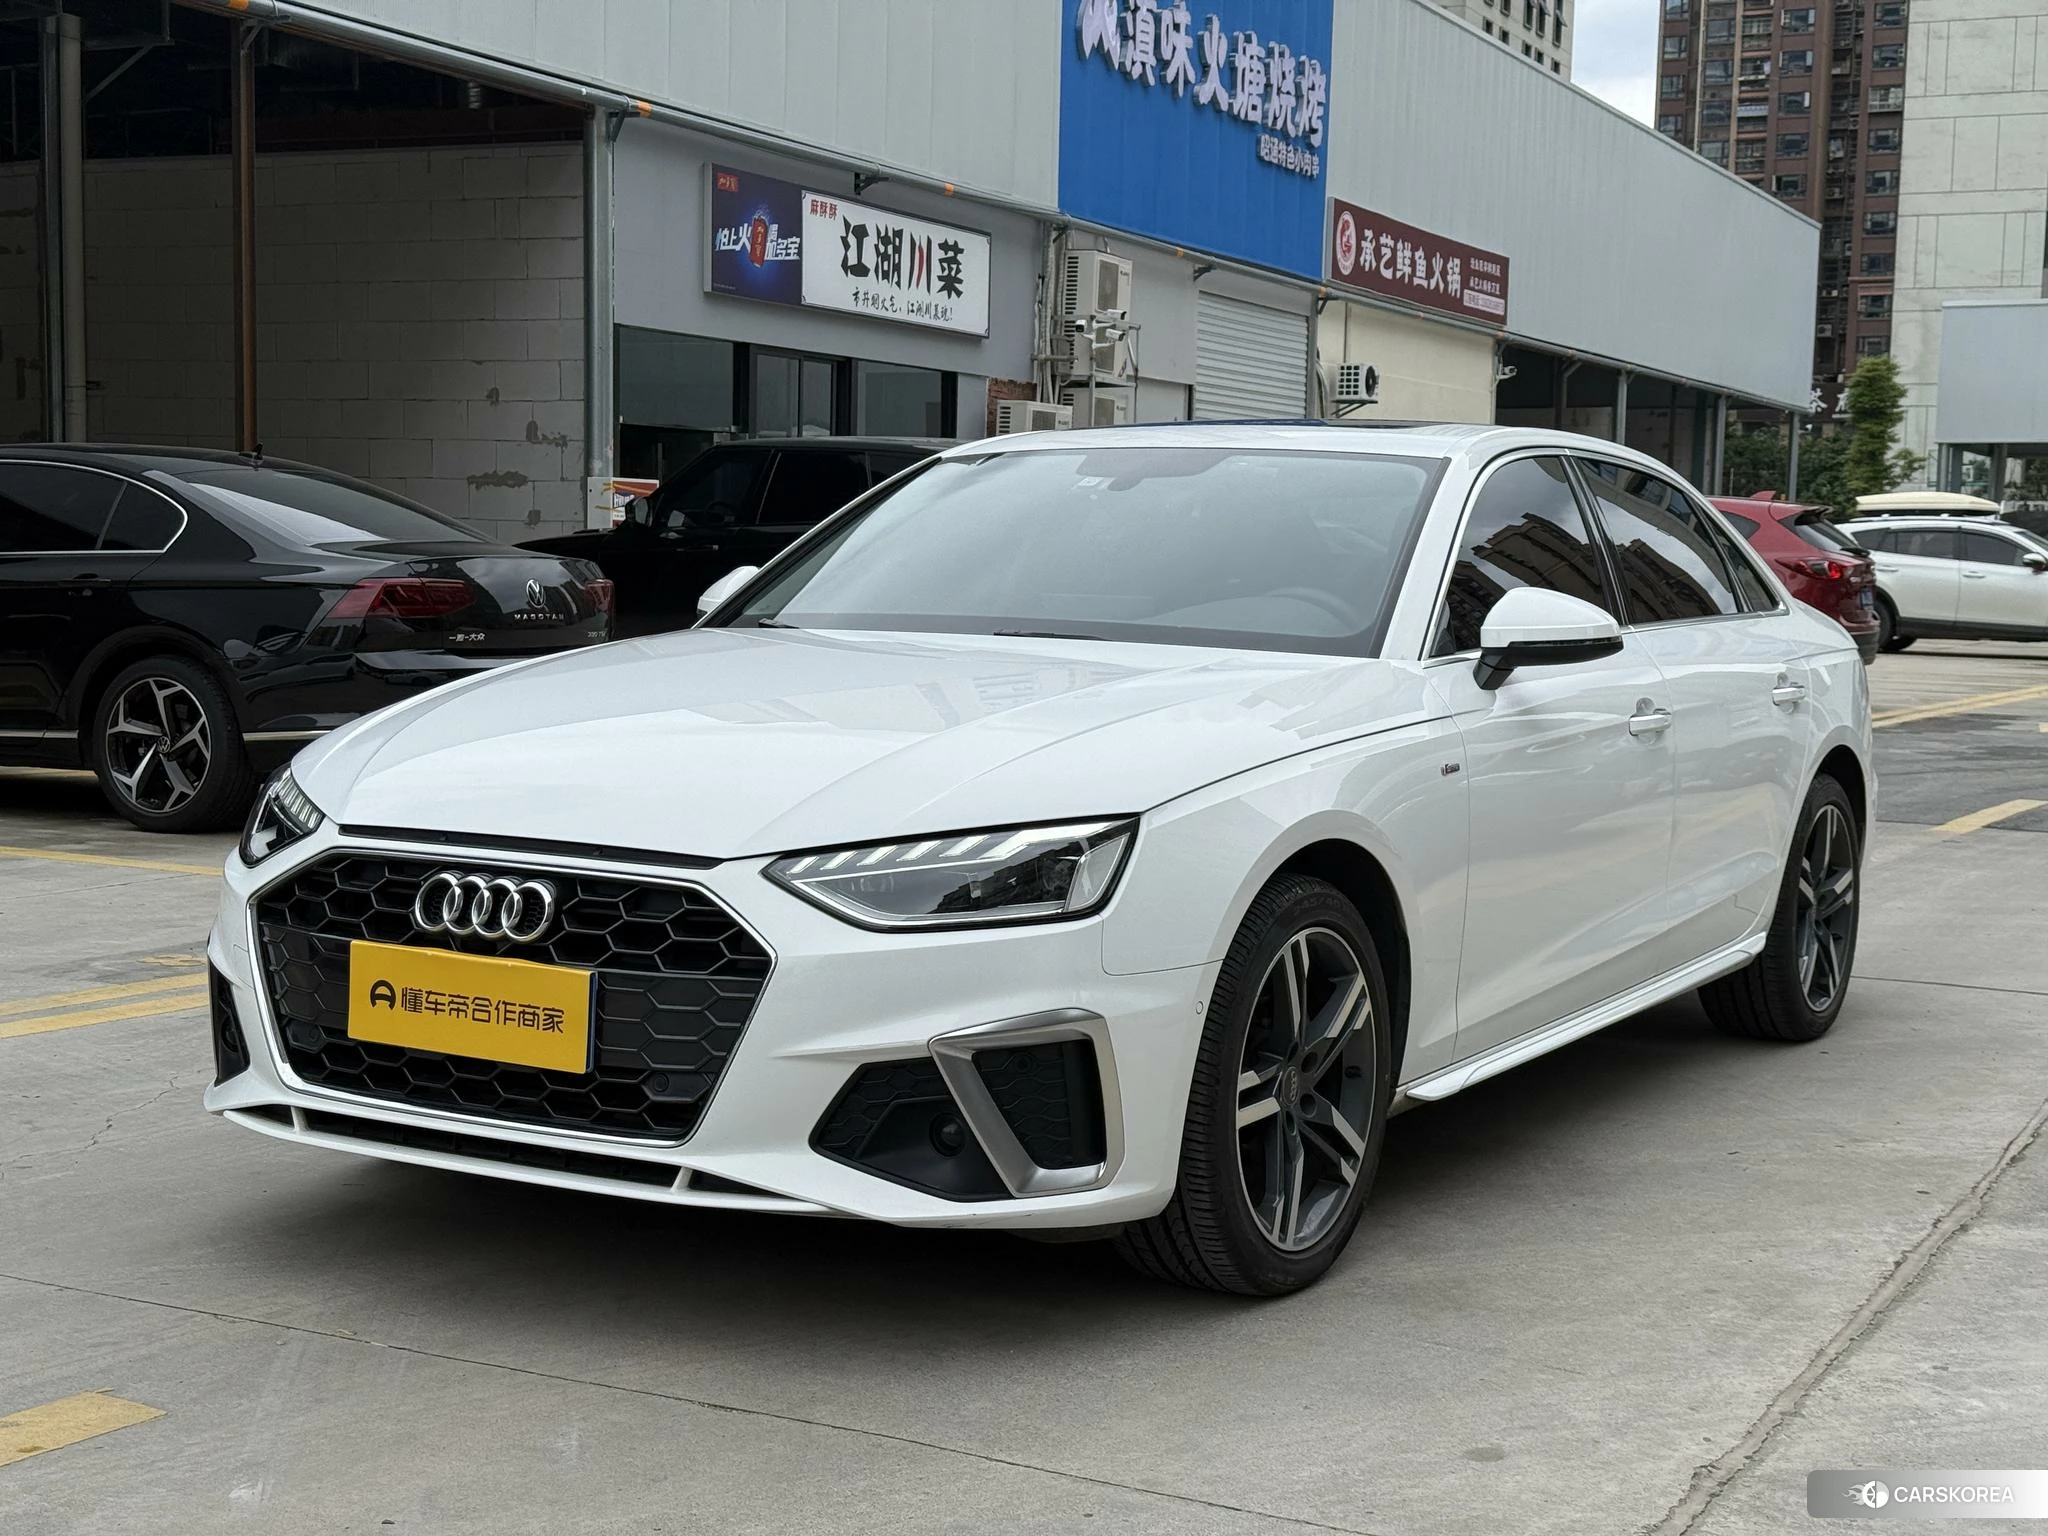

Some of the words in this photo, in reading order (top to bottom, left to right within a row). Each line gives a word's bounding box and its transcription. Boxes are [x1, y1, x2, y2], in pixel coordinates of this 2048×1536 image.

[809, 198, 838, 220] 麻酥酥
[715, 223, 752, 254] 怕上火
[840, 215, 965, 300] 江湖川菜
[1360, 229, 1461, 298] 承艺鲜鱼火锅
[401, 986, 565, 1034] 懂车帝合作商家
